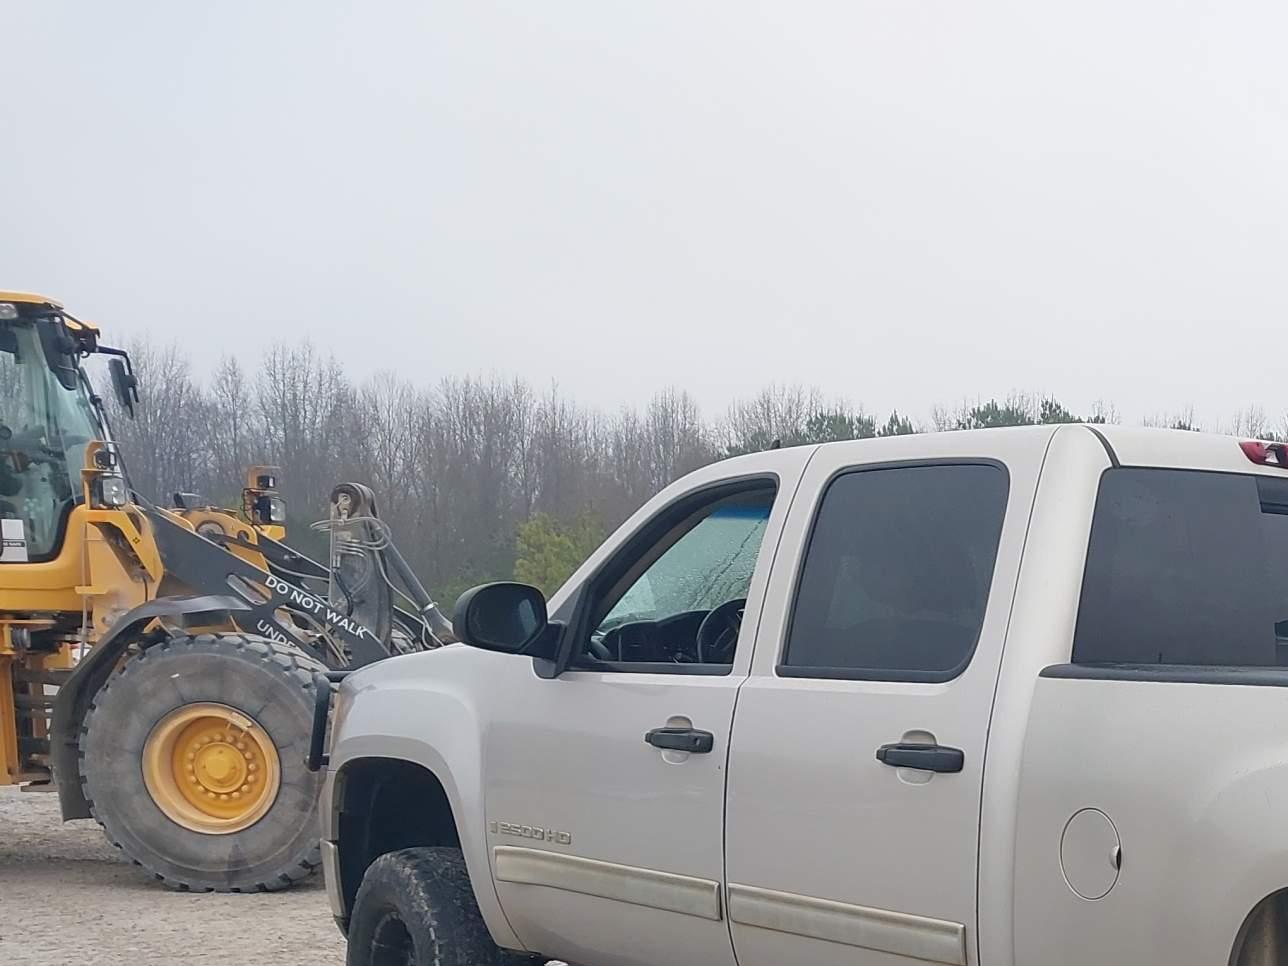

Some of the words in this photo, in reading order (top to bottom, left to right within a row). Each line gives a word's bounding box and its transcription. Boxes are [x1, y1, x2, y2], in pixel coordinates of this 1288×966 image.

[265, 576, 288, 594] DO
[290, 590, 324, 613] NOT
[326, 609, 366, 639] WALK
